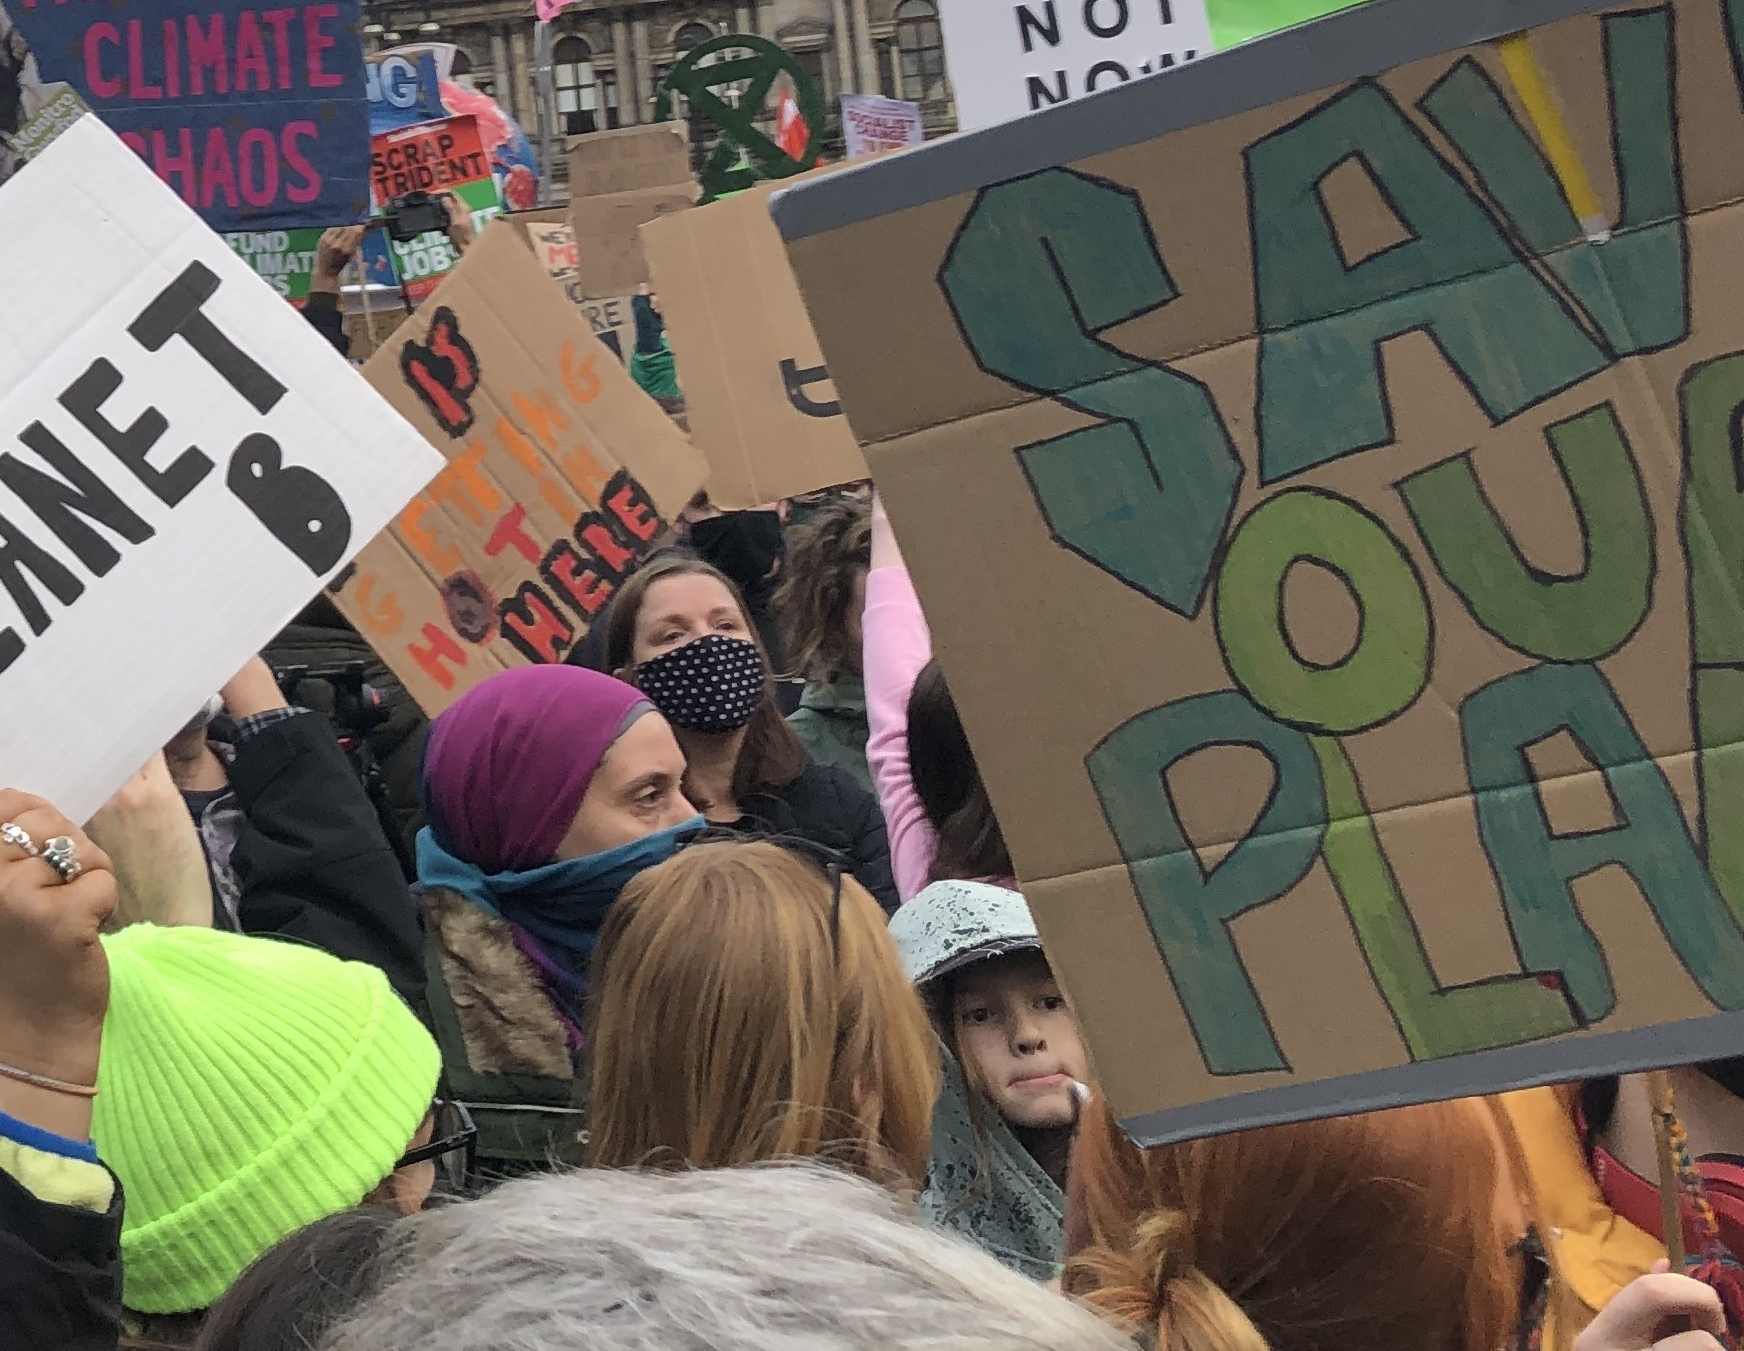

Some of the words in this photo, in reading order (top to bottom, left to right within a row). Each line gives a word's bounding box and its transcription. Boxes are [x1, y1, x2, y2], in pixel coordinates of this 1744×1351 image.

[83, 4, 345, 100] CLIMATE
[371, 134, 454, 176] SCRAP
[374, 152, 483, 198] TRIDENT
[224, 231, 290, 254] FUND
[224, 431, 353, 578] B
[356, 340, 603, 636] GETTING
[407, 502, 541, 691] HOT
[496, 466, 662, 666] HERE
